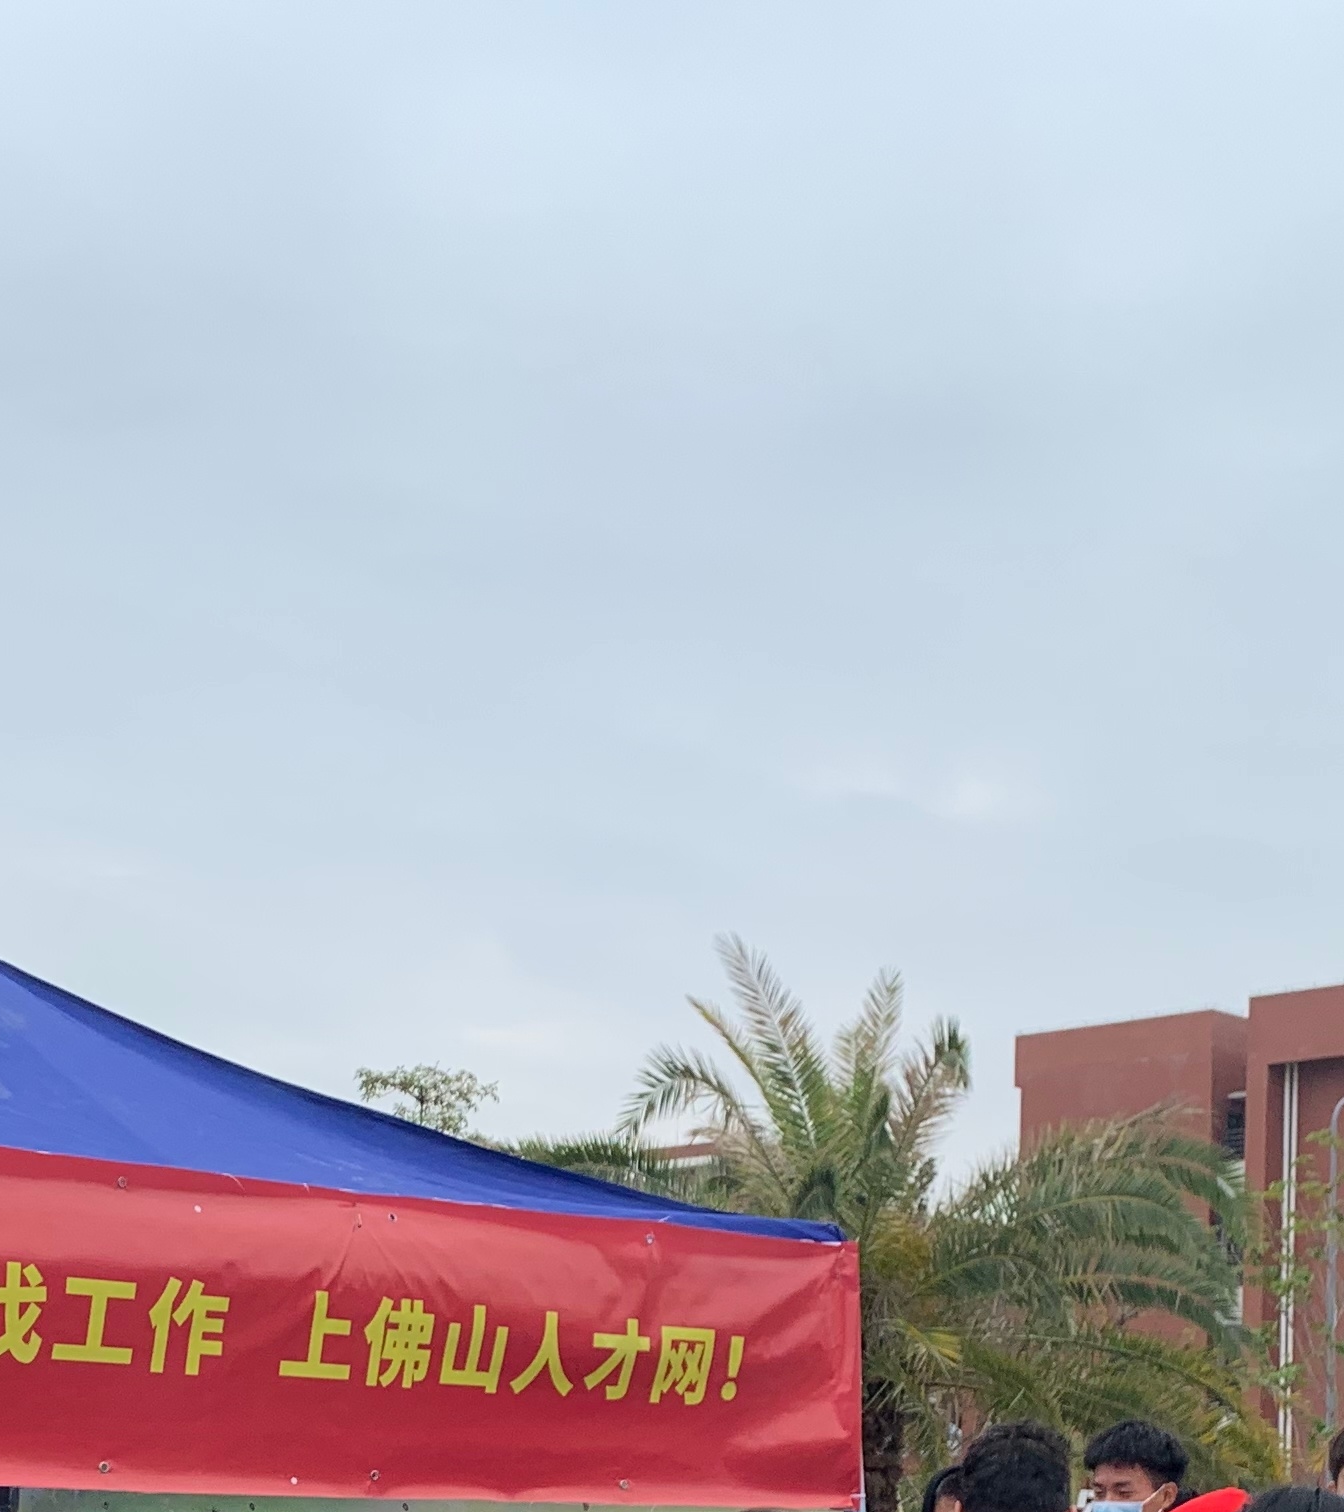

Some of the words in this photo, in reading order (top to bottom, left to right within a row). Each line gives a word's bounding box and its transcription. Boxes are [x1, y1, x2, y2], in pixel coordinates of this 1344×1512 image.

[278, 1289, 746, 1406] 上佛山人才网！
